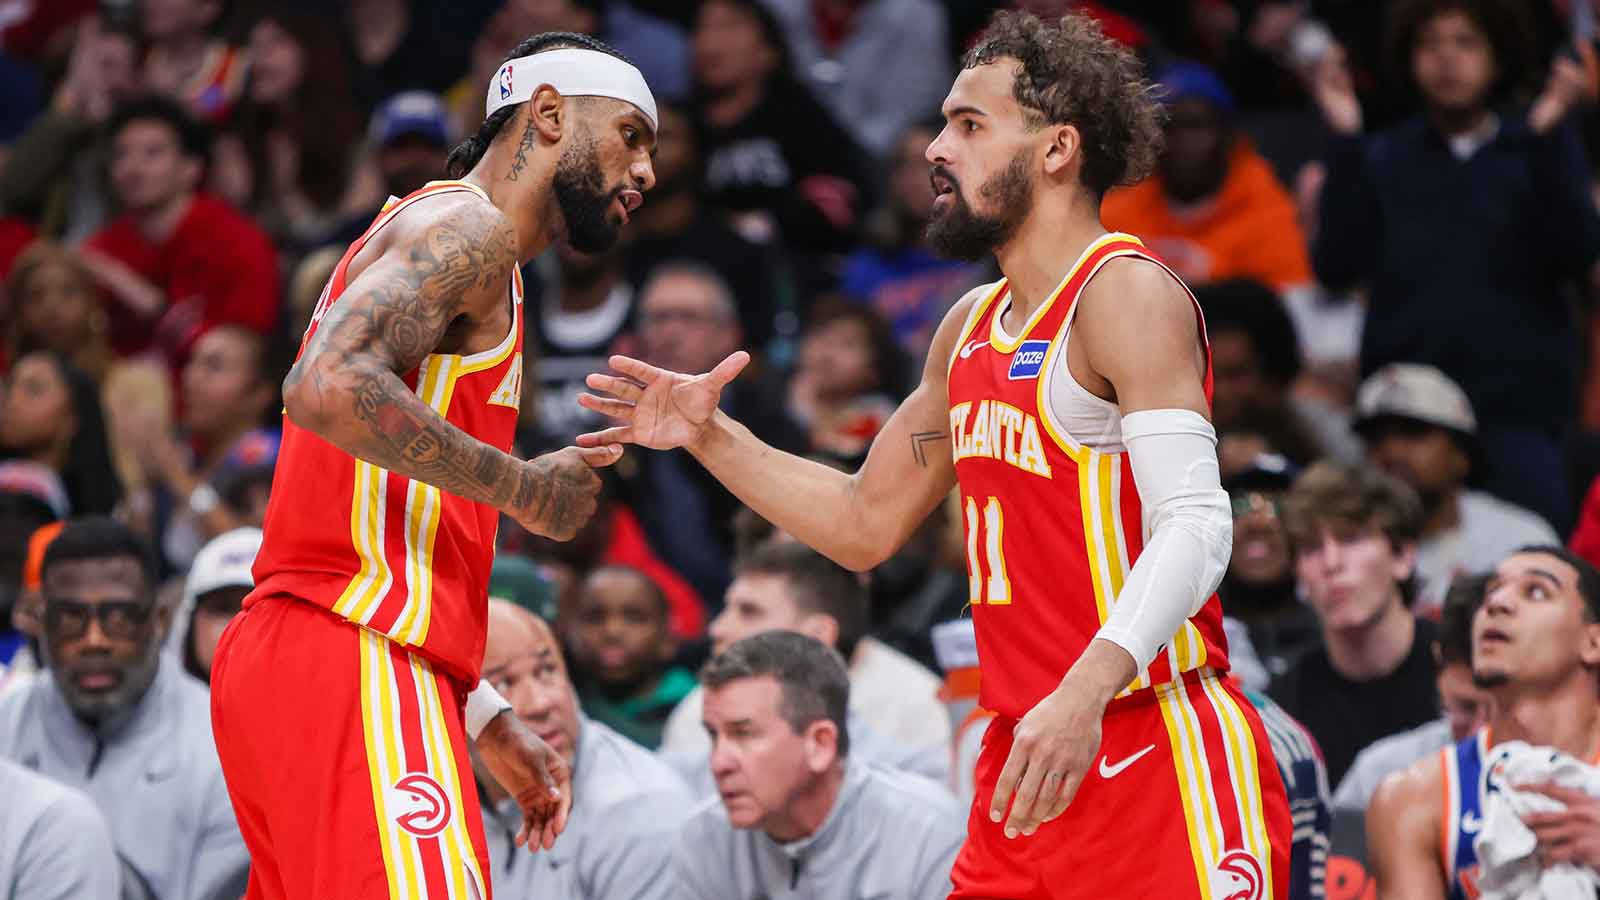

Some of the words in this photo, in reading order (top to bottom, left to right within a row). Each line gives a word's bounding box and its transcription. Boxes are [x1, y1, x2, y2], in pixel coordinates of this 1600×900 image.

[487, 352, 522, 414] A
[1013, 351, 1044, 369] paze
[949, 399, 1053, 480] TLANTA
[966, 495, 1012, 605] 11
